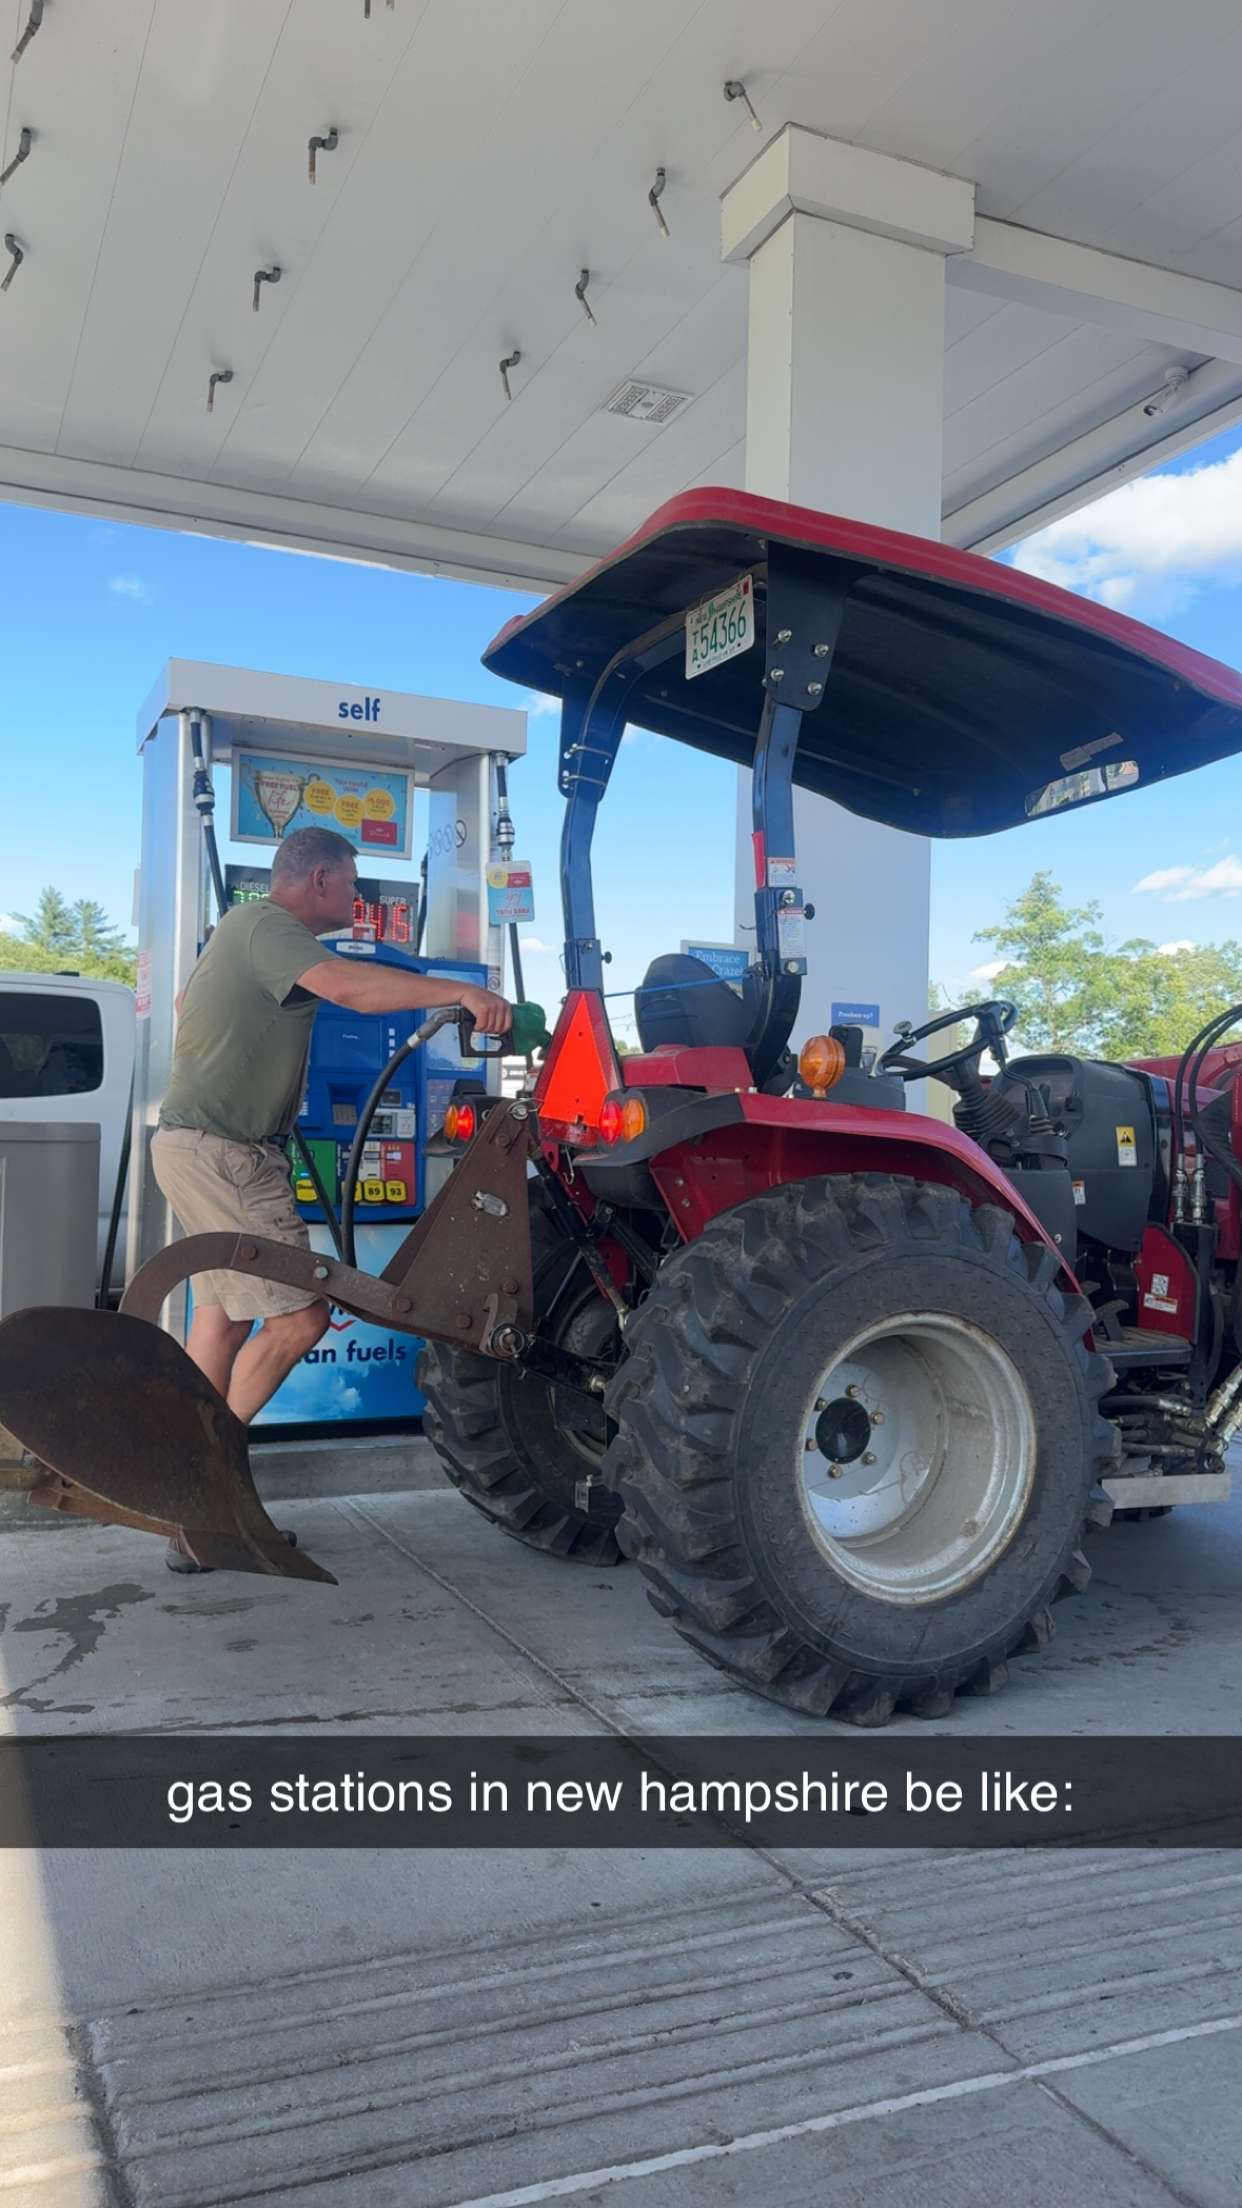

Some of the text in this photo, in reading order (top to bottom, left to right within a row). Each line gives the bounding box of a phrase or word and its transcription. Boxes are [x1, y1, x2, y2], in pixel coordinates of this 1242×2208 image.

[700, 600, 747, 660] 54366
[338, 696, 381, 722] self
[240, 881, 270, 893] DIESEL
[379, 895, 406, 905] SUPER
[696, 951, 741, 964] Embrace
[368, 1187, 381, 1196] 89
[390, 1187, 402, 1196] 93
[346, 1338, 407, 1363] fuels
